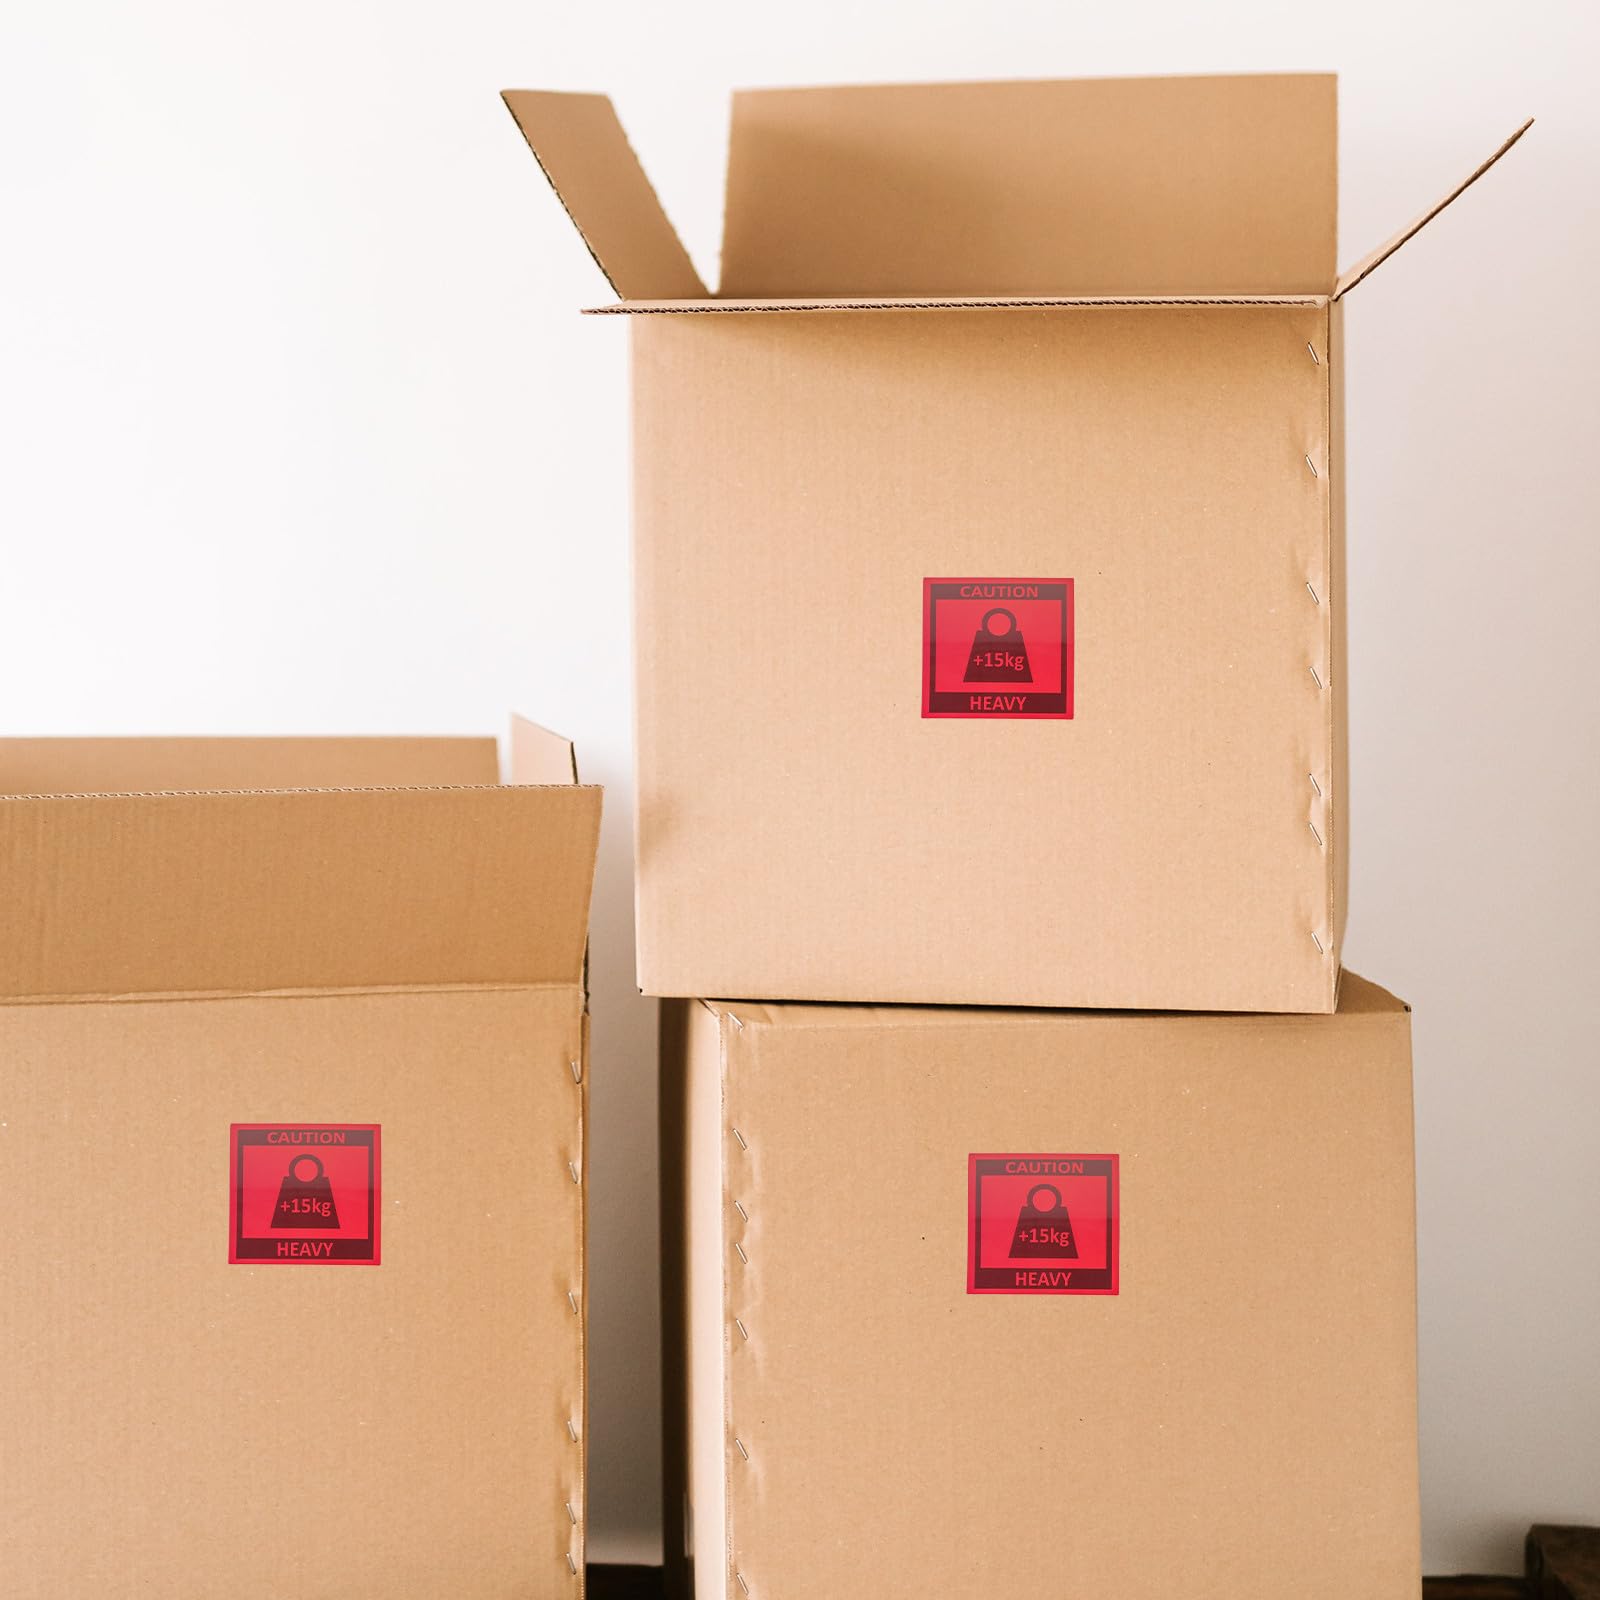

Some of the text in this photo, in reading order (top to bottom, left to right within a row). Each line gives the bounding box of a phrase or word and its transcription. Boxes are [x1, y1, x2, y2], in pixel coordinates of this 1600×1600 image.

[960, 584, 1039, 599] CAUTION
[973, 651, 1025, 672] +15kg
[969, 695, 1027, 712] HEAVY
[267, 1130, 346, 1145] CAUTION
[1005, 1160, 1084, 1175] CAUTION
[280, 1197, 332, 1218] +15kg
[1018, 1227, 1070, 1248] +15kg
[276, 1241, 334, 1258] HEAVY
[1014, 1271, 1072, 1288] HEAVY
